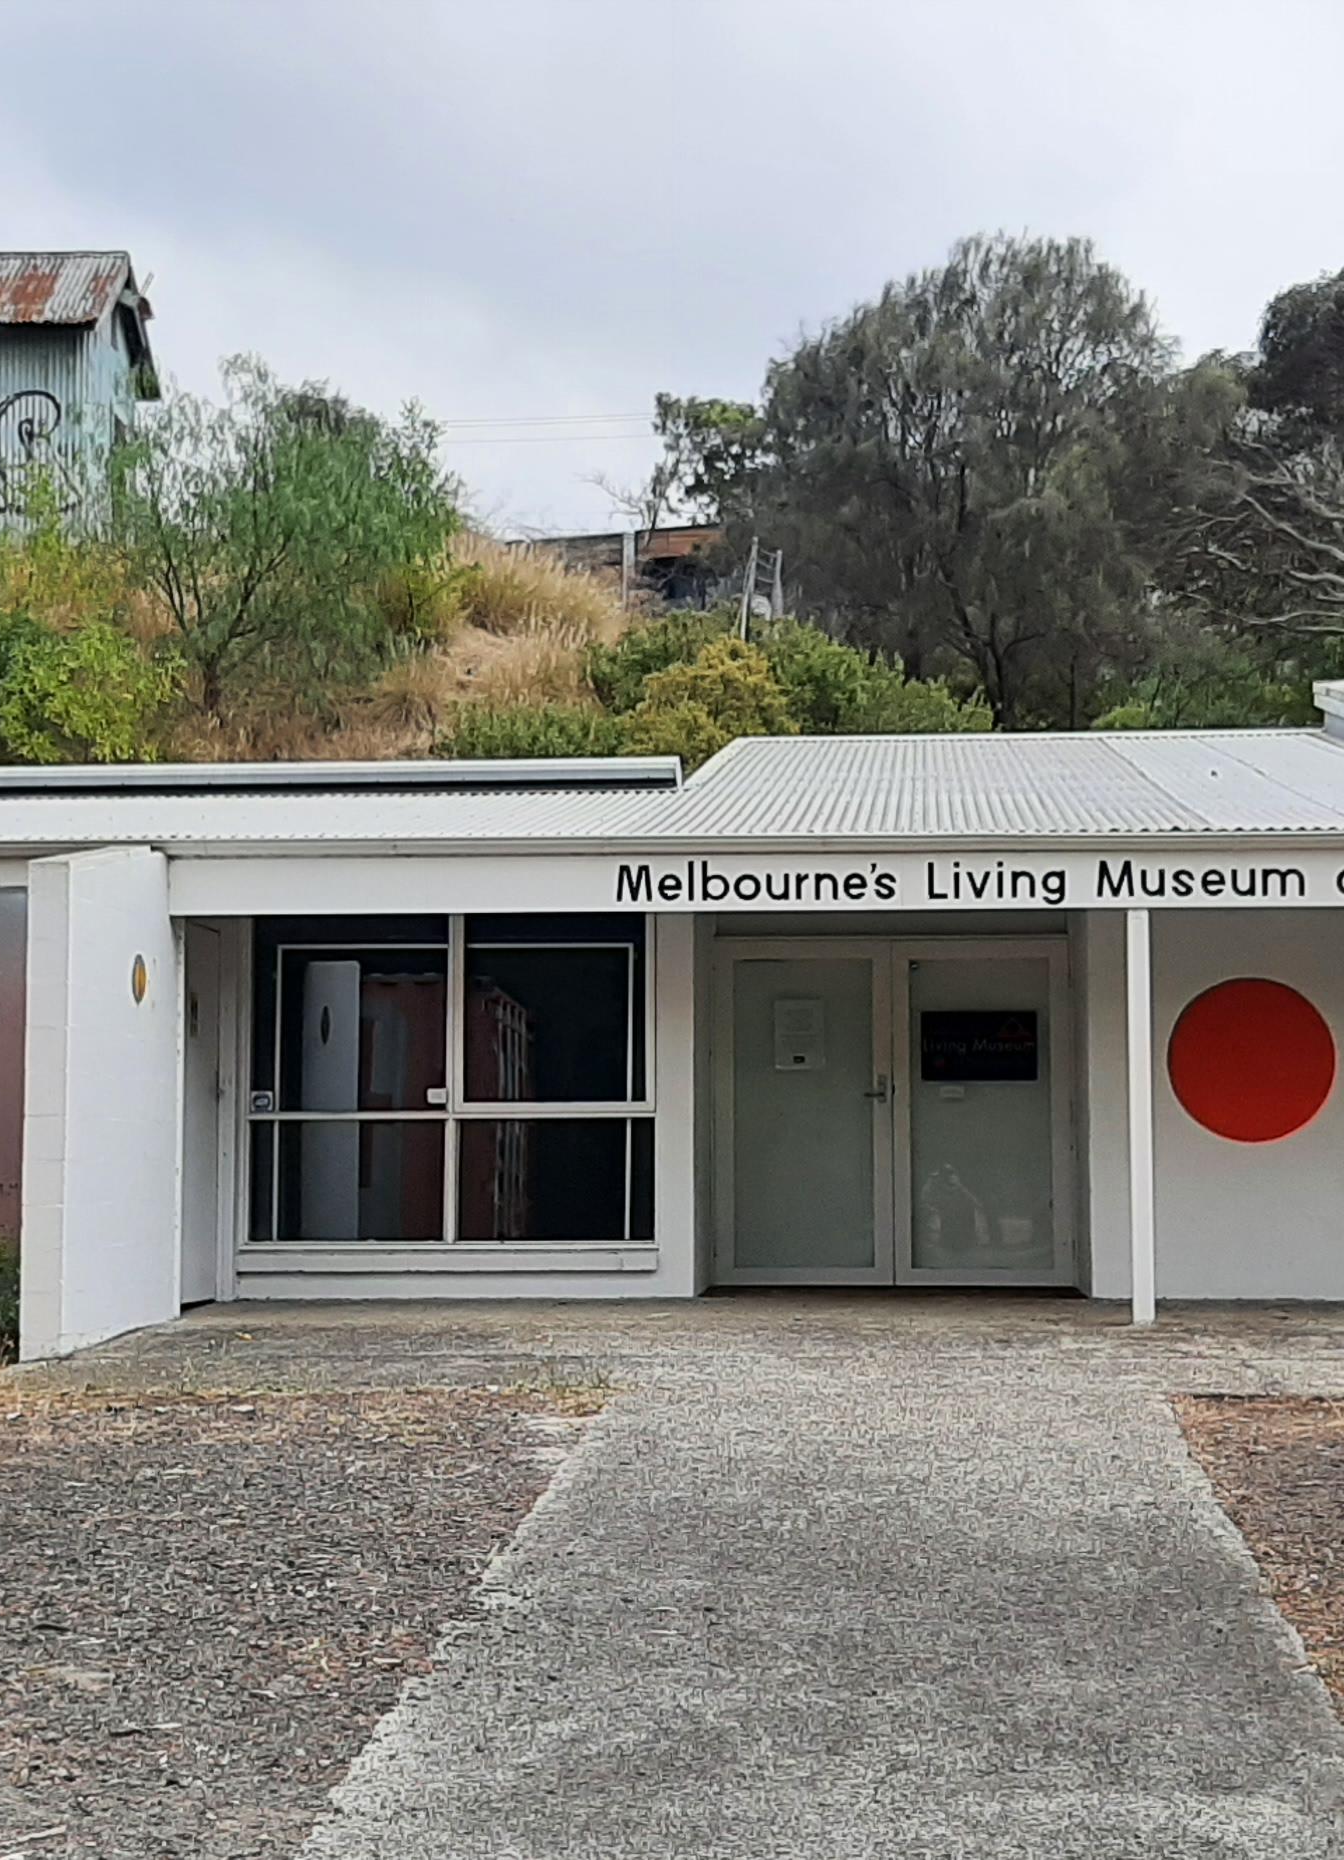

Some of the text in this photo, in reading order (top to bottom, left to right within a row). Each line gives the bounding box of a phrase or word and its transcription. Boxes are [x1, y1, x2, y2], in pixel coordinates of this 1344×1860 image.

[616, 860, 897, 902] Melbourne's
[927, 860, 1066, 906] Living
[1096, 860, 1305, 898] Museum
[922, 1037, 1035, 1055] Living Museum
